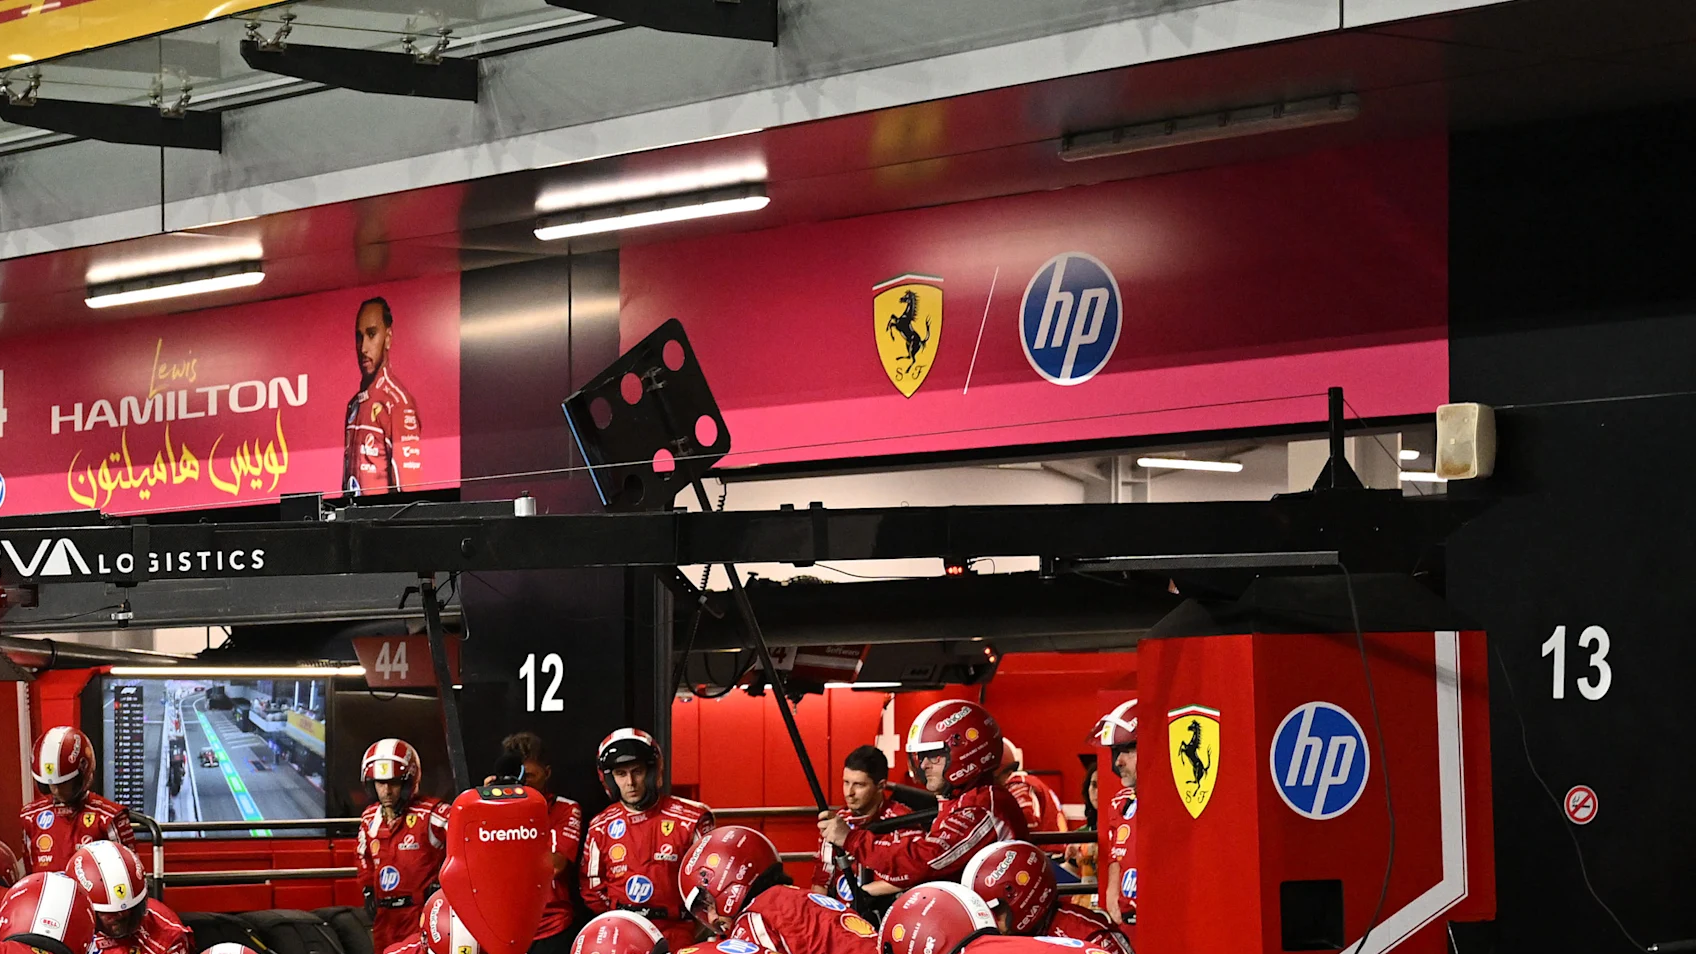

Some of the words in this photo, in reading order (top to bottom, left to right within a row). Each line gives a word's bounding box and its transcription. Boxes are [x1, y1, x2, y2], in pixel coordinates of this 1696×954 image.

[1028, 251, 1112, 384] hp
[148, 338, 199, 398] Lewis
[51, 374, 309, 435] HAMILTON
[67, 421, 201, 508] هاميلتون
[208, 409, 289, 497] لويس
[375, 641, 408, 680] 44
[1541, 625, 1613, 701] 13
[519, 652, 564, 712] 12
[944, 706, 973, 727] UniCredit
[949, 763, 977, 781] CEVA
[1276, 704, 1364, 817] hp
[39, 811, 53, 830] hp
[479, 826, 538, 842] brembo
[609, 820, 625, 839] hp
[382, 866, 398, 890] hp
[992, 850, 1017, 880] UniCredit
[628, 875, 651, 902] hp
[724, 884, 741, 914] CEVA
[41, 917, 59, 929] BELL
[1017, 905, 1040, 930] CEVA
